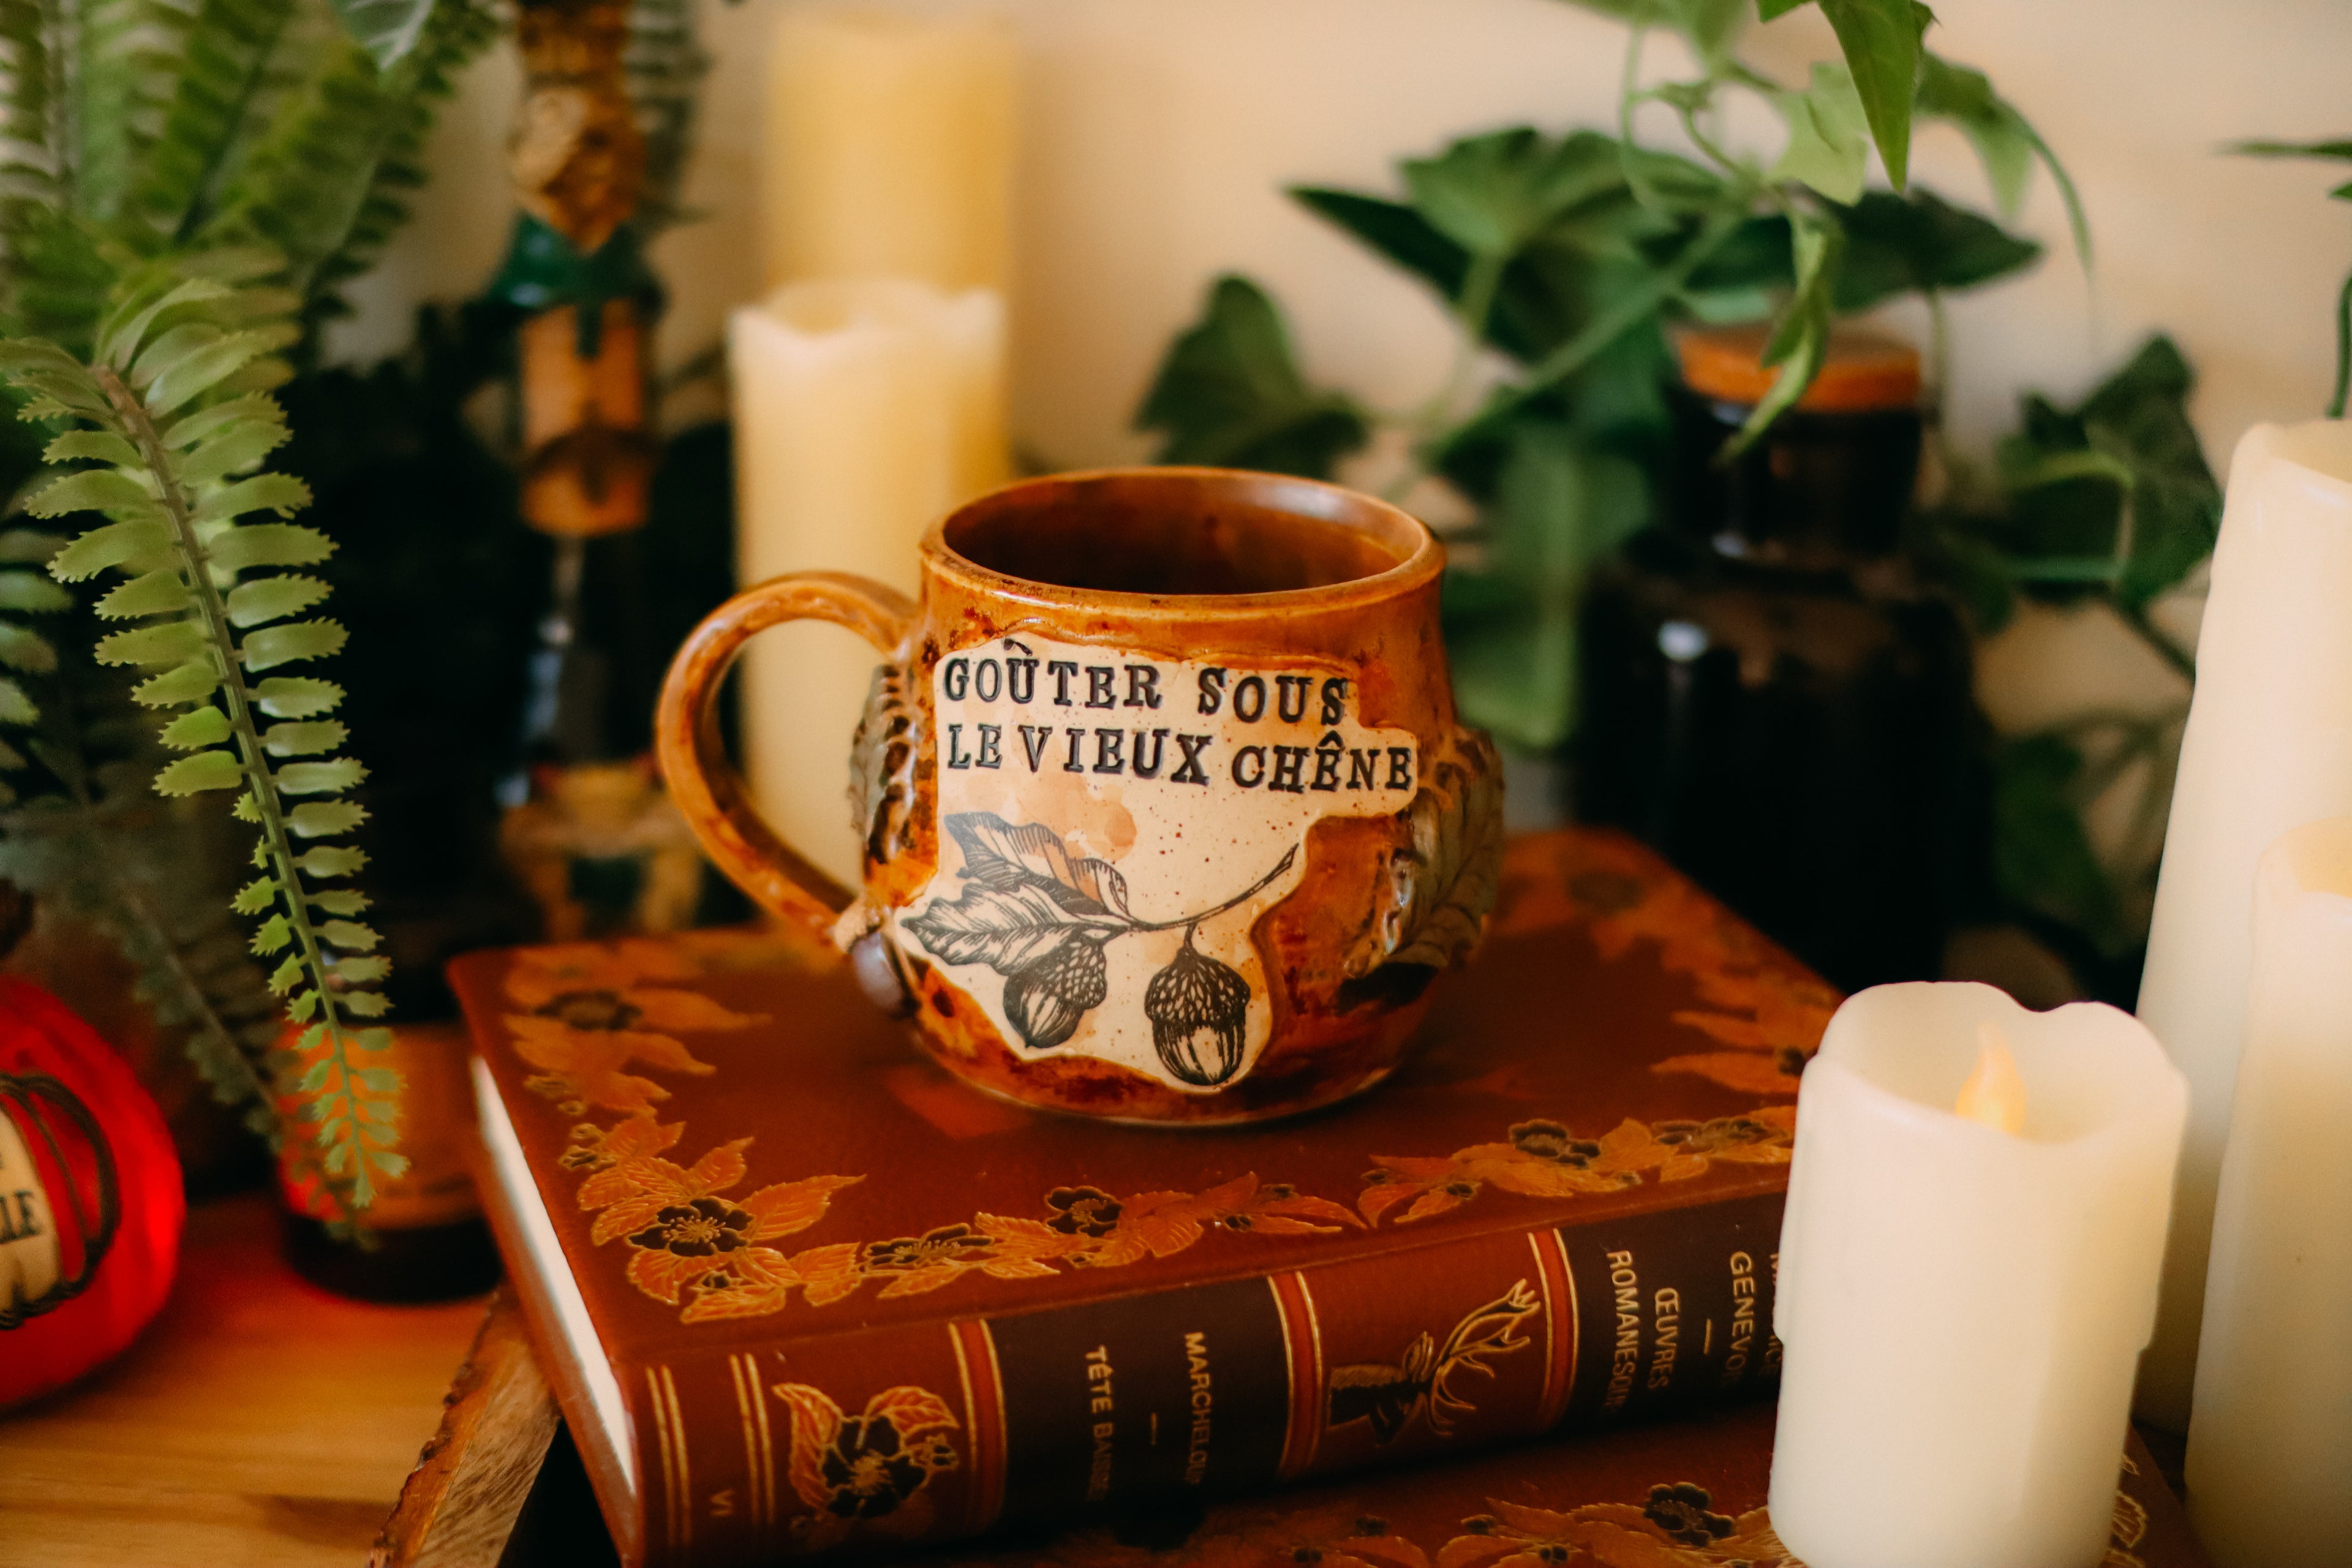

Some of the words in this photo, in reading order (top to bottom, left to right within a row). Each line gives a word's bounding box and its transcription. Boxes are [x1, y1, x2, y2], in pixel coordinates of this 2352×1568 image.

[1197, 667, 1349, 726] SOUS
[948, 723, 1003, 769] LE
[1017, 725, 1213, 786] VIEUX
[1231, 733, 1412, 793] CHÊNE
[1648, 1287, 1680, 1390] ŒUVRES
[1085, 1344, 1114, 1414] TÊTE
